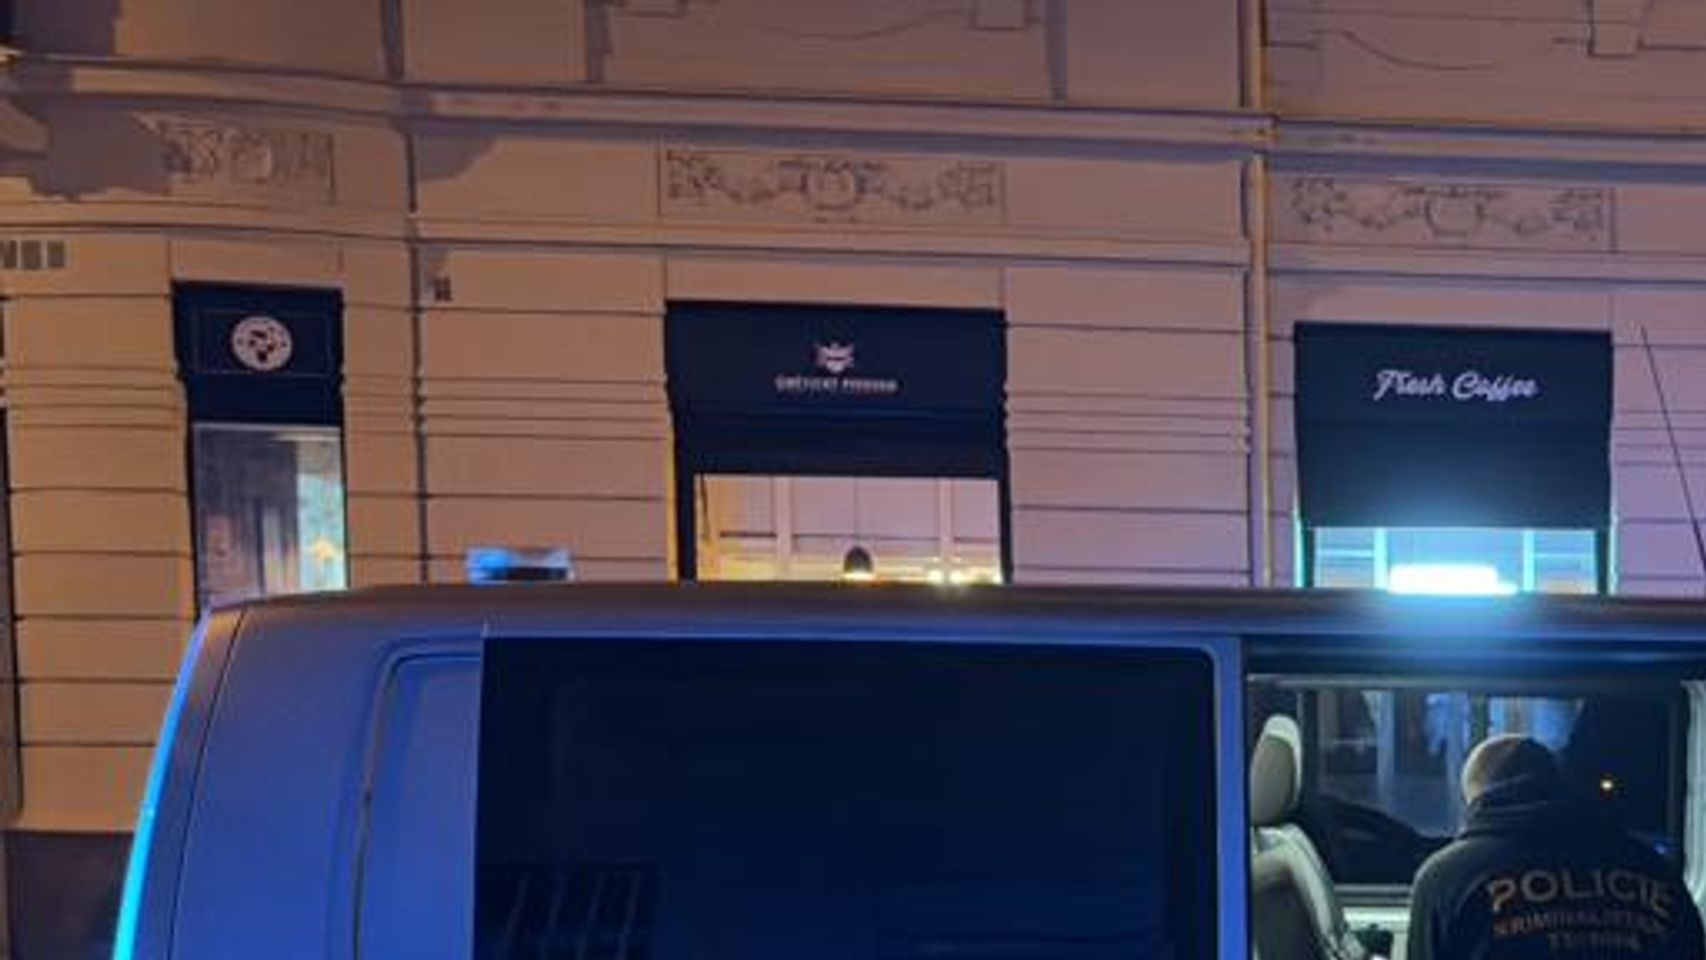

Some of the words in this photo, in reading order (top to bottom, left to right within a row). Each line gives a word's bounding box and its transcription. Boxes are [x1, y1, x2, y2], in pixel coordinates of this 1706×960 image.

[1373, 369, 1445, 401] Fresh
[1452, 369, 1540, 402] Coffee
[1488, 867, 1672, 919] POLICIE
